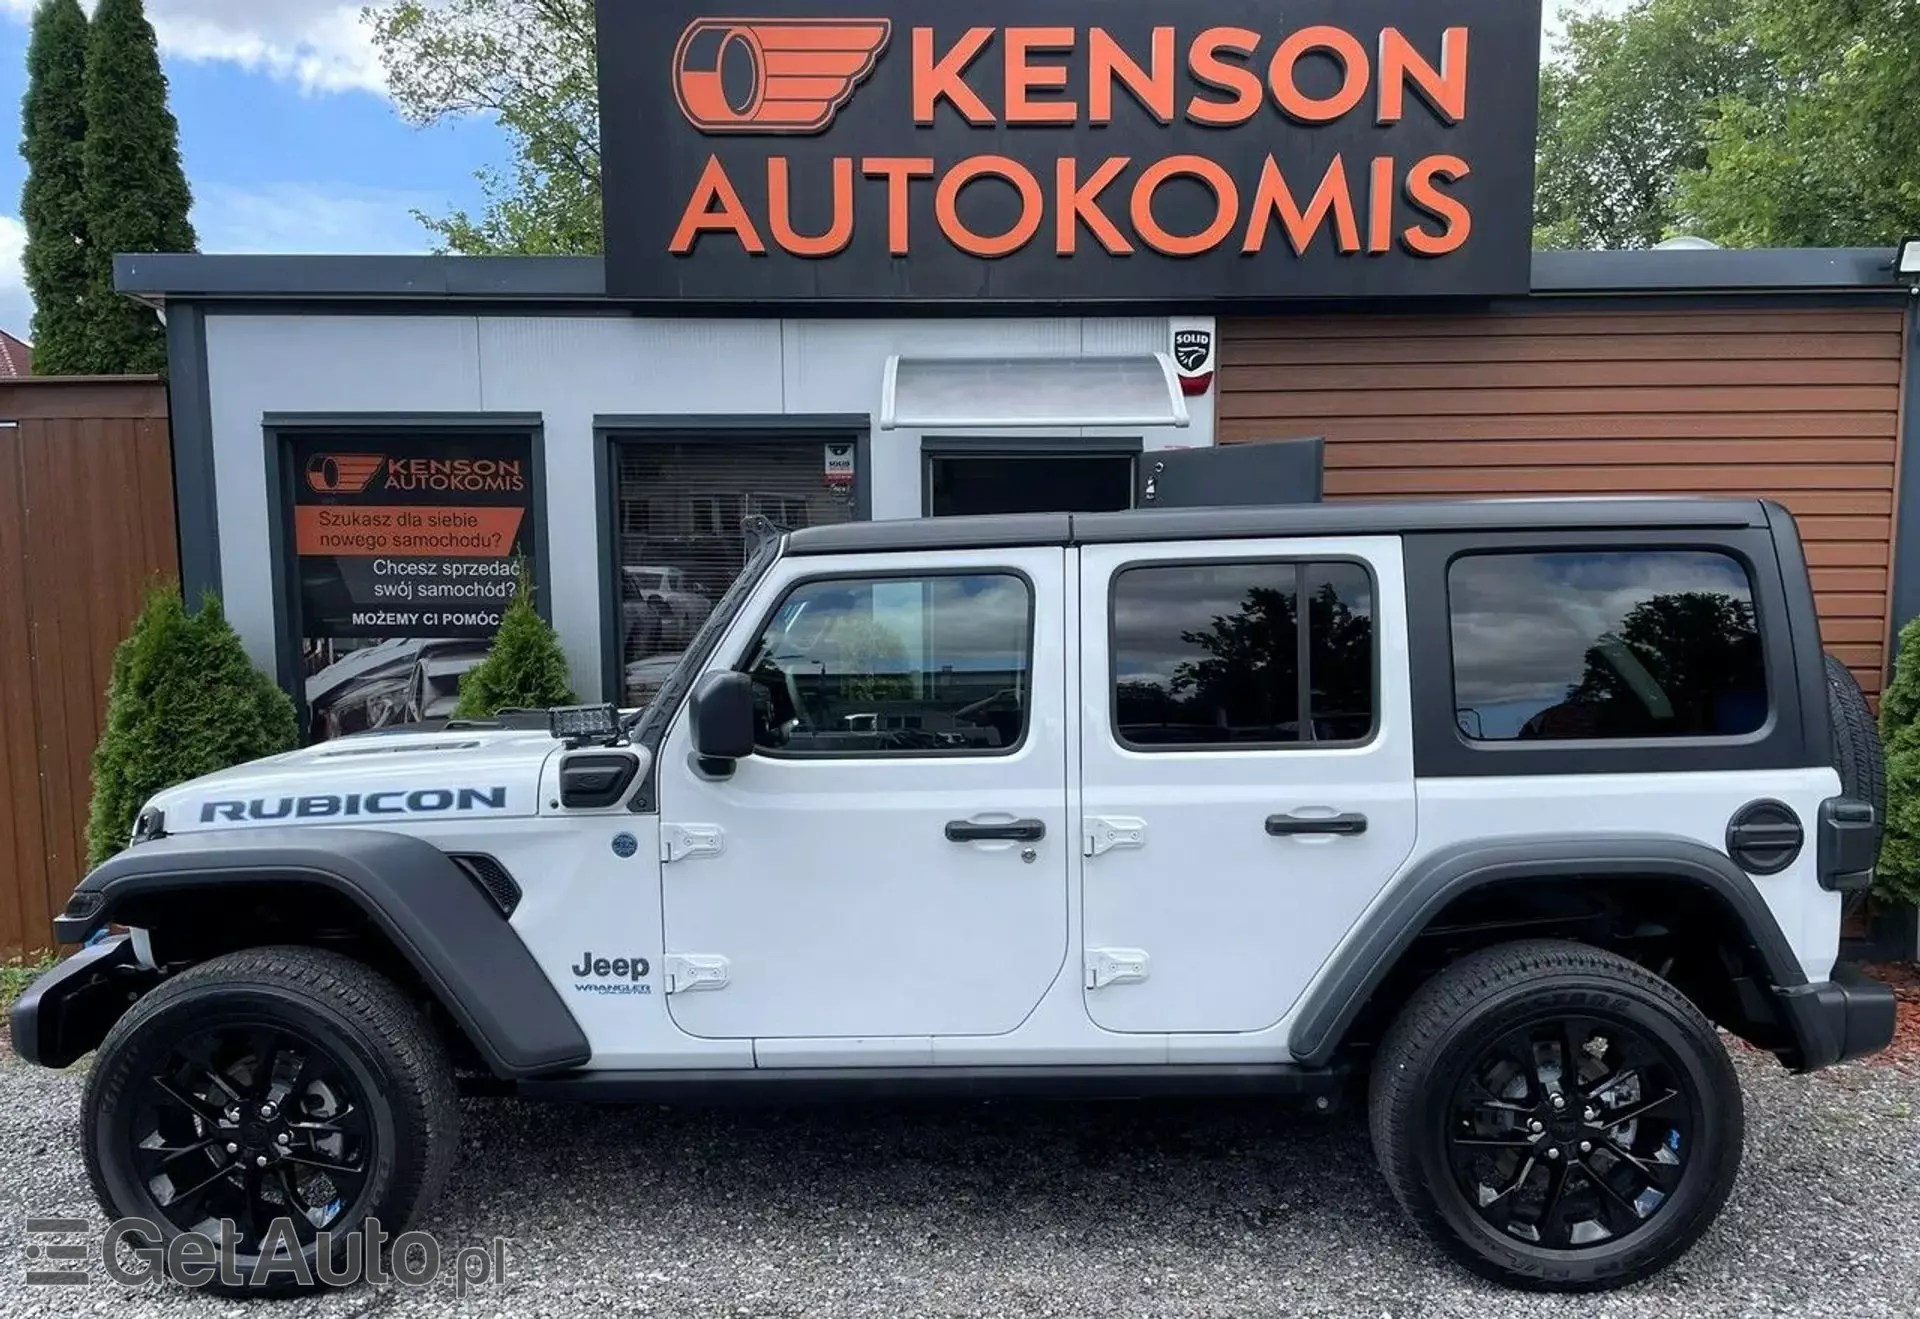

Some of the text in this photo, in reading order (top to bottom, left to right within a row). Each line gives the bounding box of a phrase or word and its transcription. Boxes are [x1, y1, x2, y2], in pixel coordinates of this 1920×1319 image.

[913, 26, 1467, 126] KENSON
[668, 154, 1471, 257] AUTOKOMIS
[1176, 334, 1209, 344] SOLID
[388, 459, 519, 475] KENSON
[384, 474, 524, 491] AUTOKOMIS
[319, 511, 478, 528] Szukasz dla siebie
[320, 532, 502, 549] nowego samochodu?
[373, 559, 520, 578] Chcesz sprzedać
[374, 581, 516, 600] swój samochód?
[352, 610, 419, 625] MOŻEMY
[423, 613, 438, 625] CI
[200, 786, 507, 823] RUBICON
[572, 952, 650, 982] Jeep
[575, 984, 651, 992] WRANGLER
